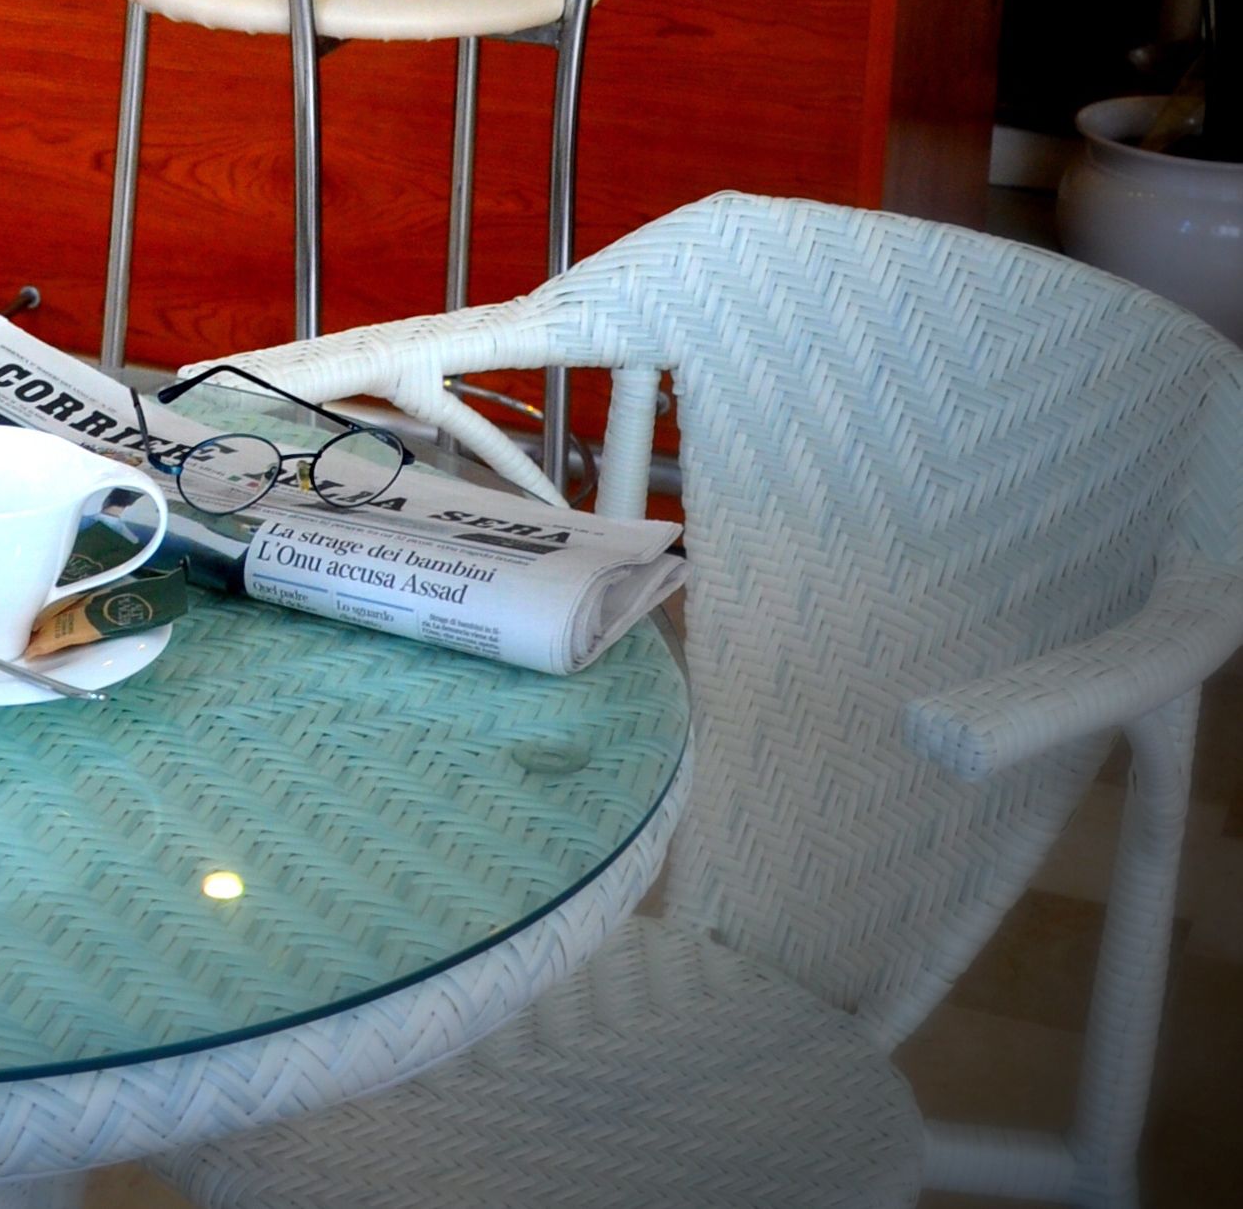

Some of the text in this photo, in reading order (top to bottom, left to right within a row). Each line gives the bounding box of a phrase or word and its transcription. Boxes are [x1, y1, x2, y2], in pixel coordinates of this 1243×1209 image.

[427, 510, 571, 544] SERA
[267, 523, 295, 540] La
[298, 532, 364, 557] strage
[367, 544, 404, 563] dei
[405, 551, 498, 583] bambini
[256, 540, 469, 605] L'Onu accusa Assad
[280, 589, 309, 602] padre
[336, 599, 351, 612] Lo
[352, 605, 395, 622] sguardo
